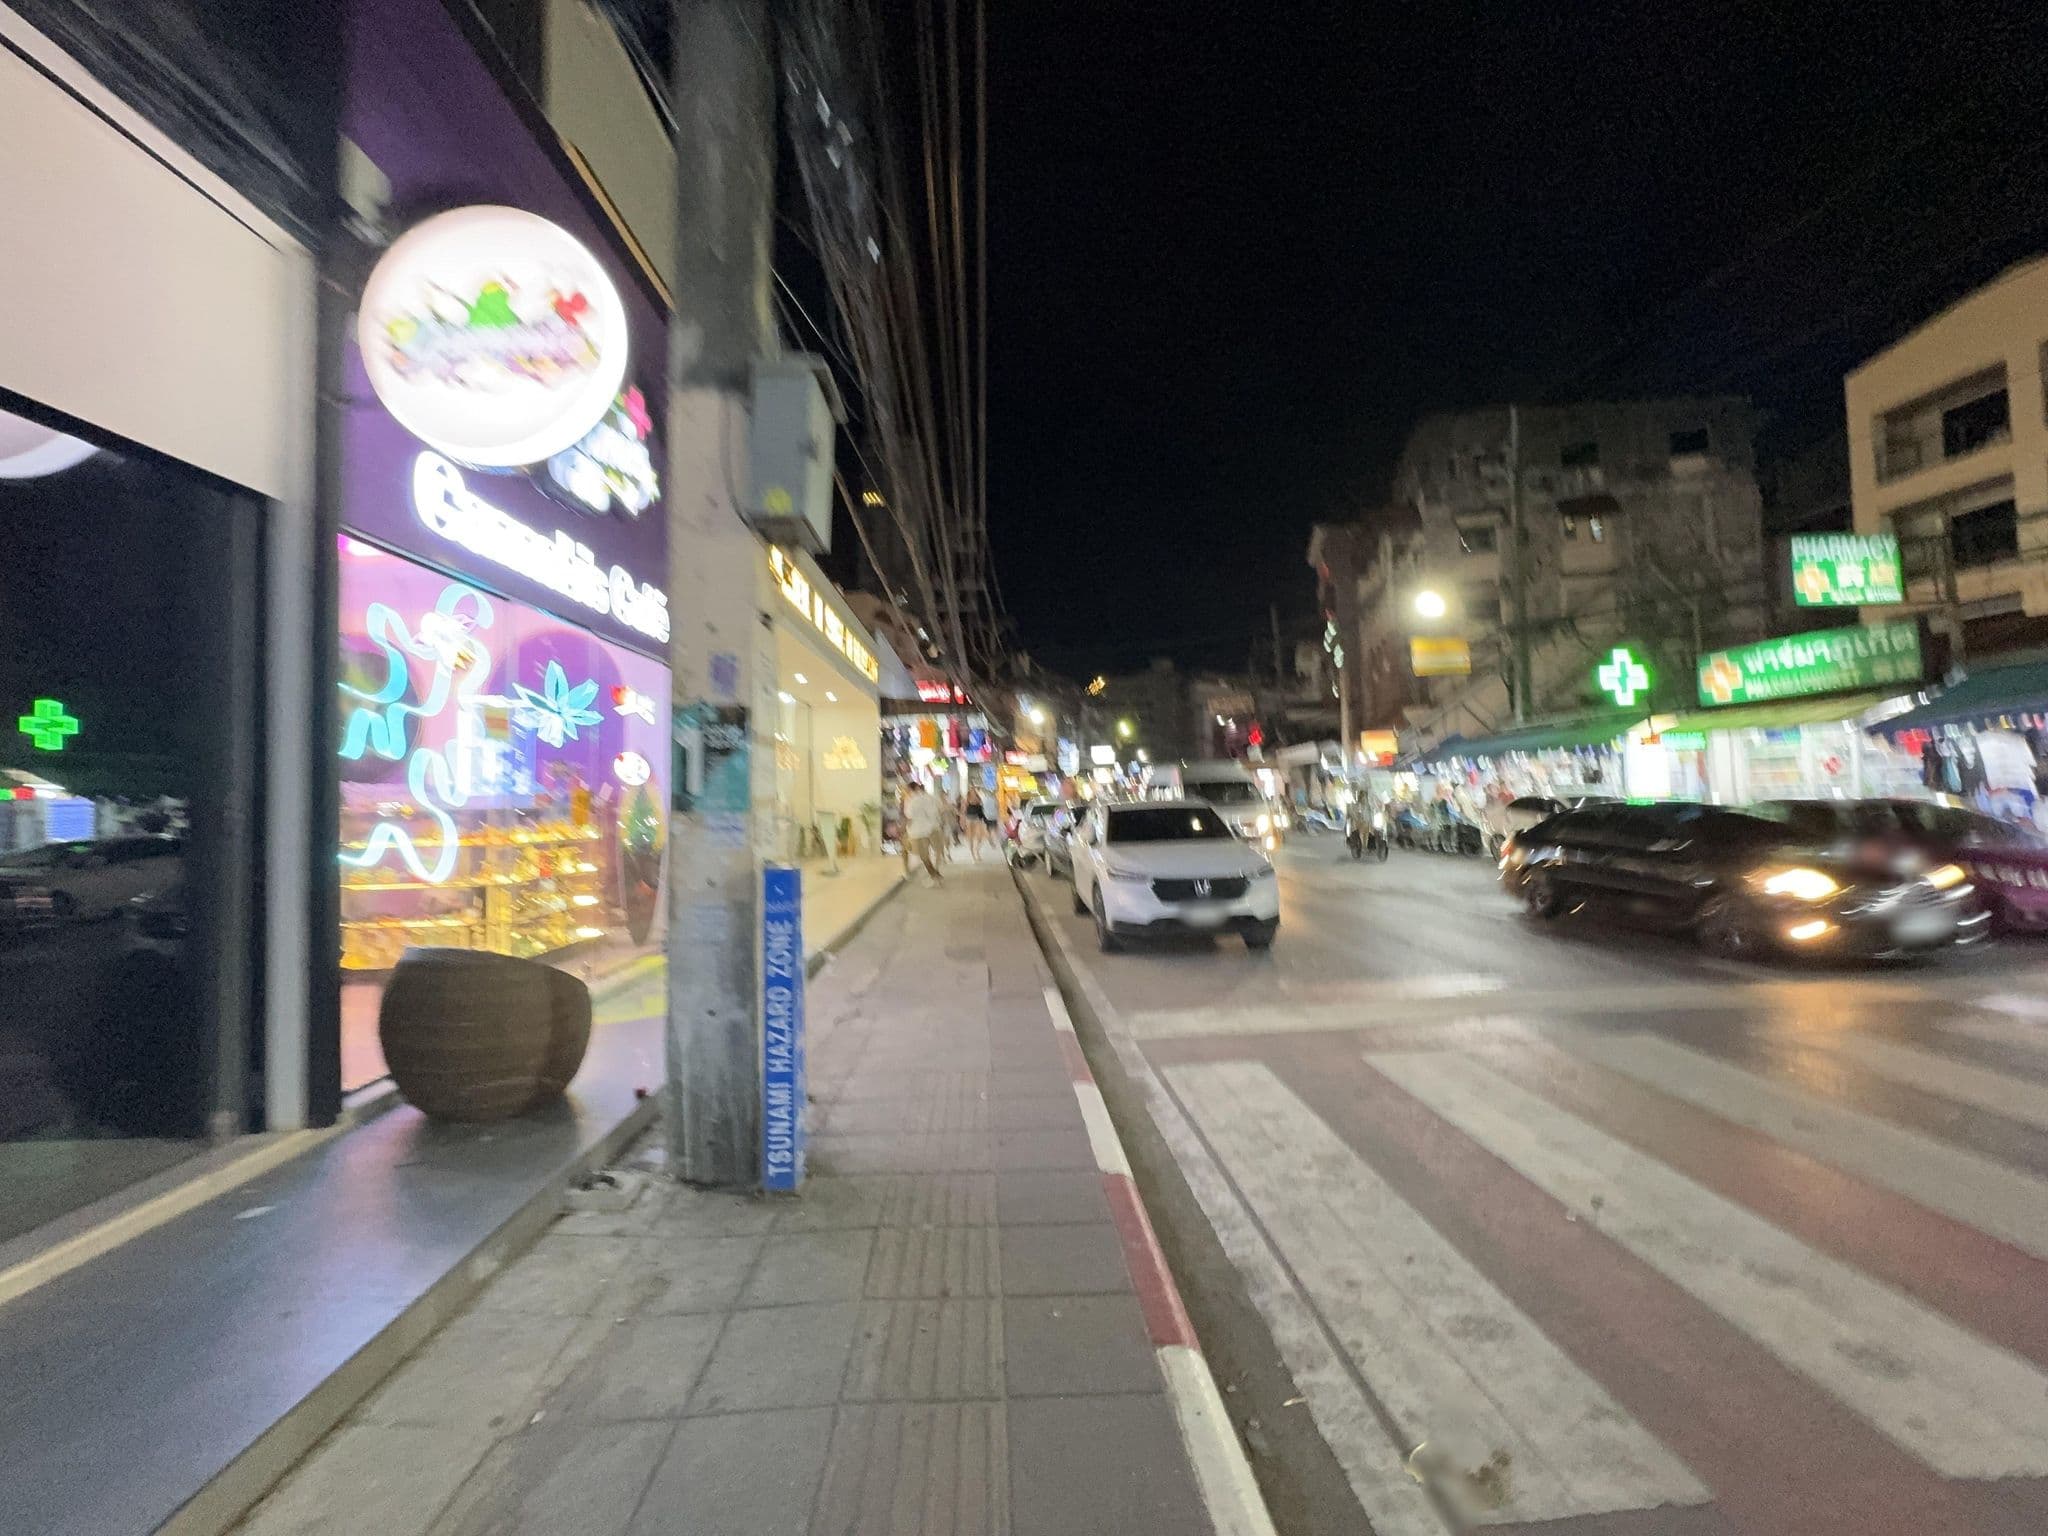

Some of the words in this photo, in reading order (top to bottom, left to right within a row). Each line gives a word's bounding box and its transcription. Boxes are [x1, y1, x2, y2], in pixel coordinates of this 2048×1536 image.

[1791, 534, 1897, 561] PHARMACY
[767, 919, 793, 979] ZONE
[767, 986, 793, 1073] HAZARD
[767, 1082, 793, 1178] TSUNAMI
